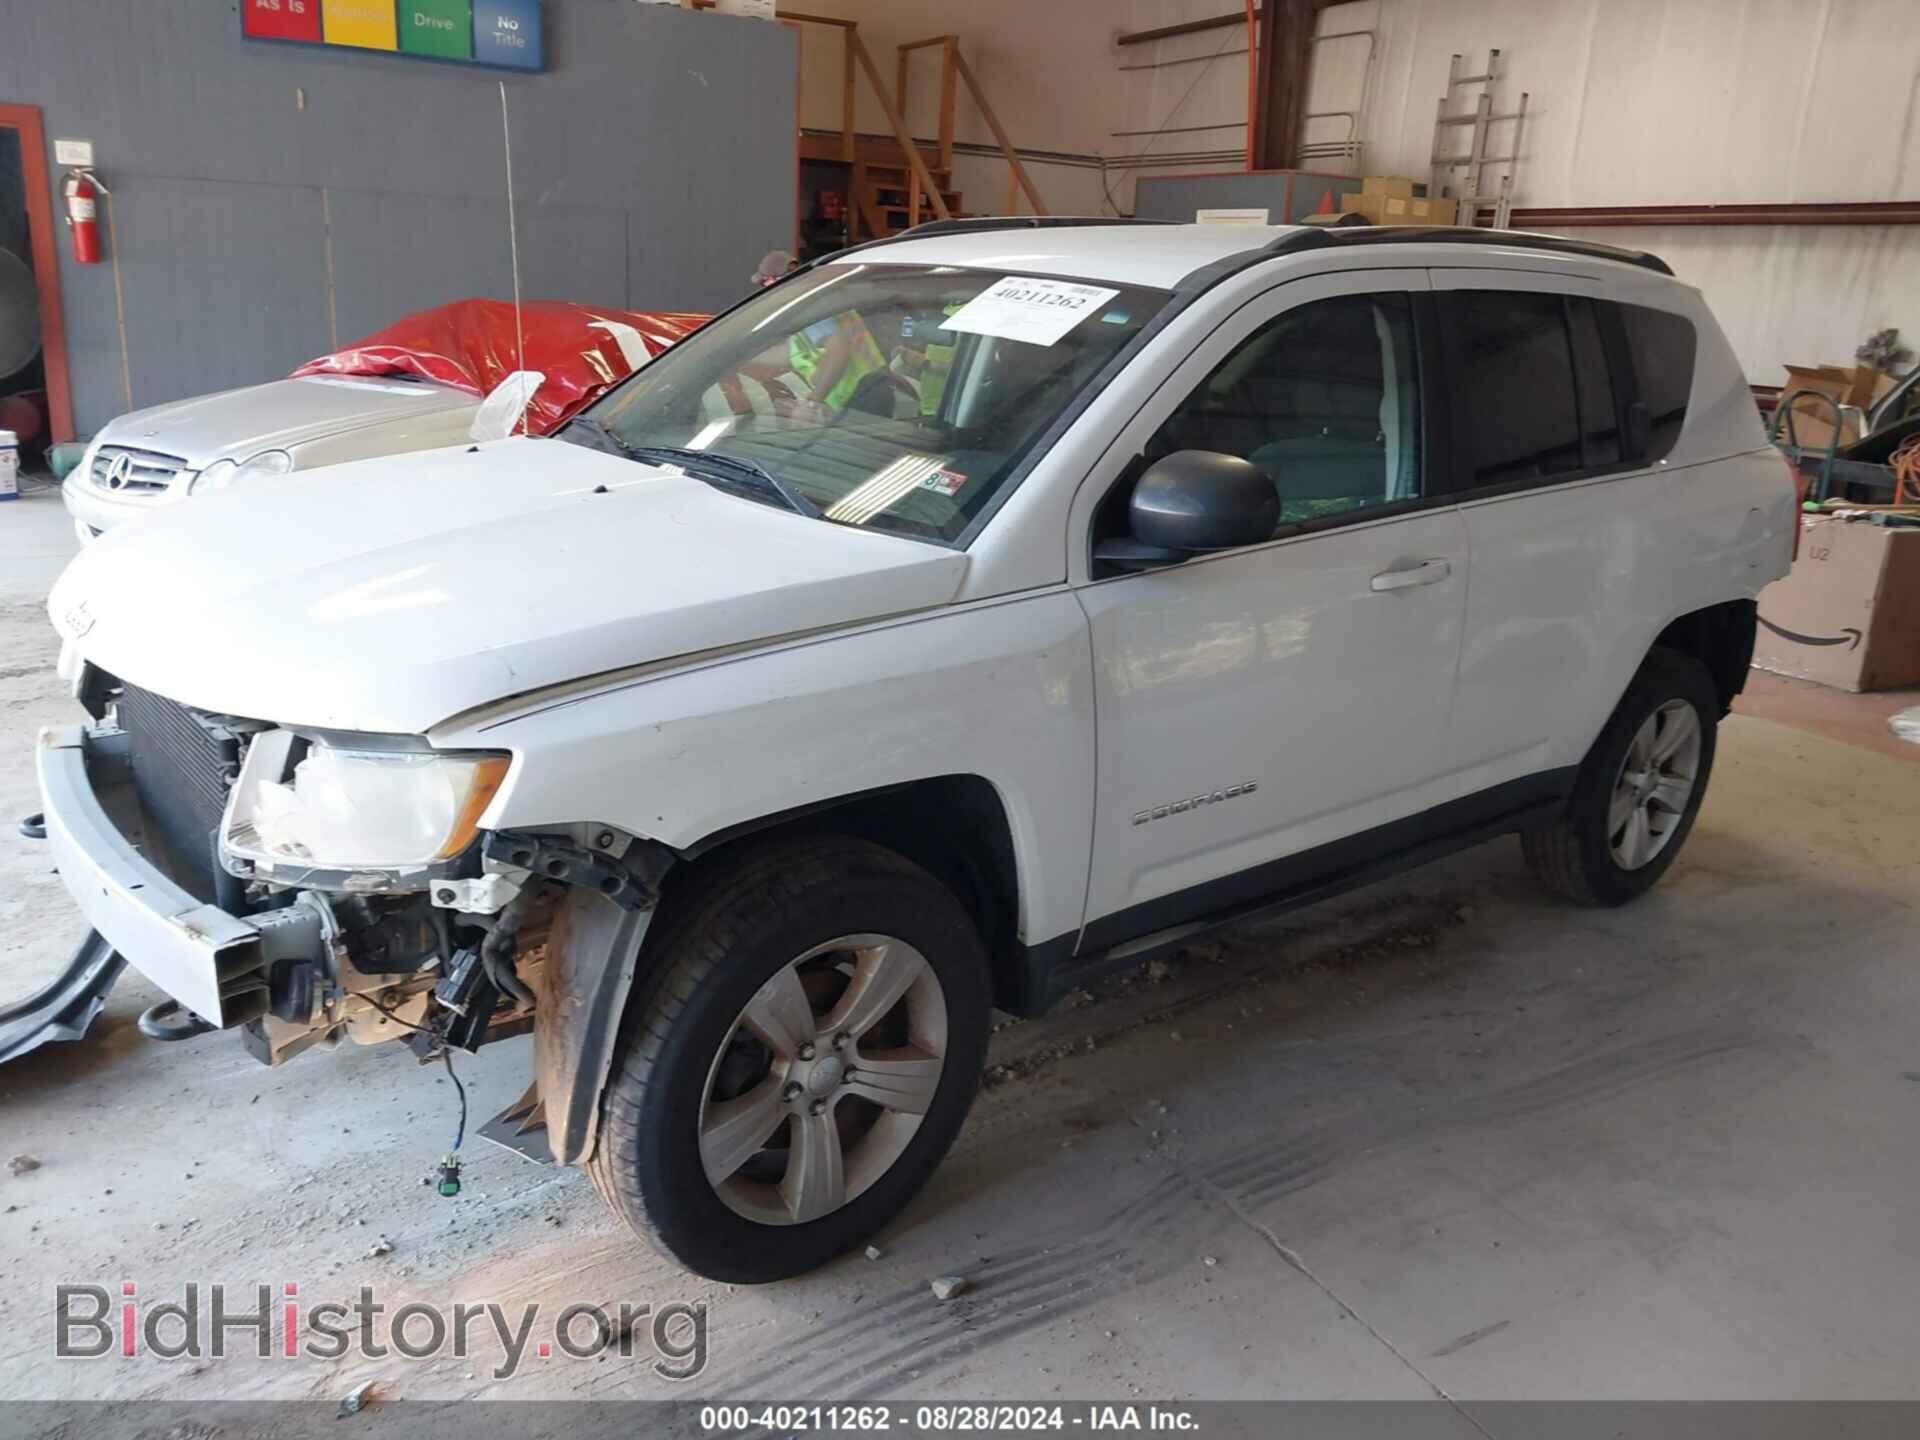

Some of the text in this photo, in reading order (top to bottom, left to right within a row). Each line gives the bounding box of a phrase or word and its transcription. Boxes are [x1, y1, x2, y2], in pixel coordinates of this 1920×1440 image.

[414, 12, 454, 31] Drive
[497, 16, 519, 30] No
[493, 31, 525, 48] Title
[995, 286, 1087, 310] 40211262
